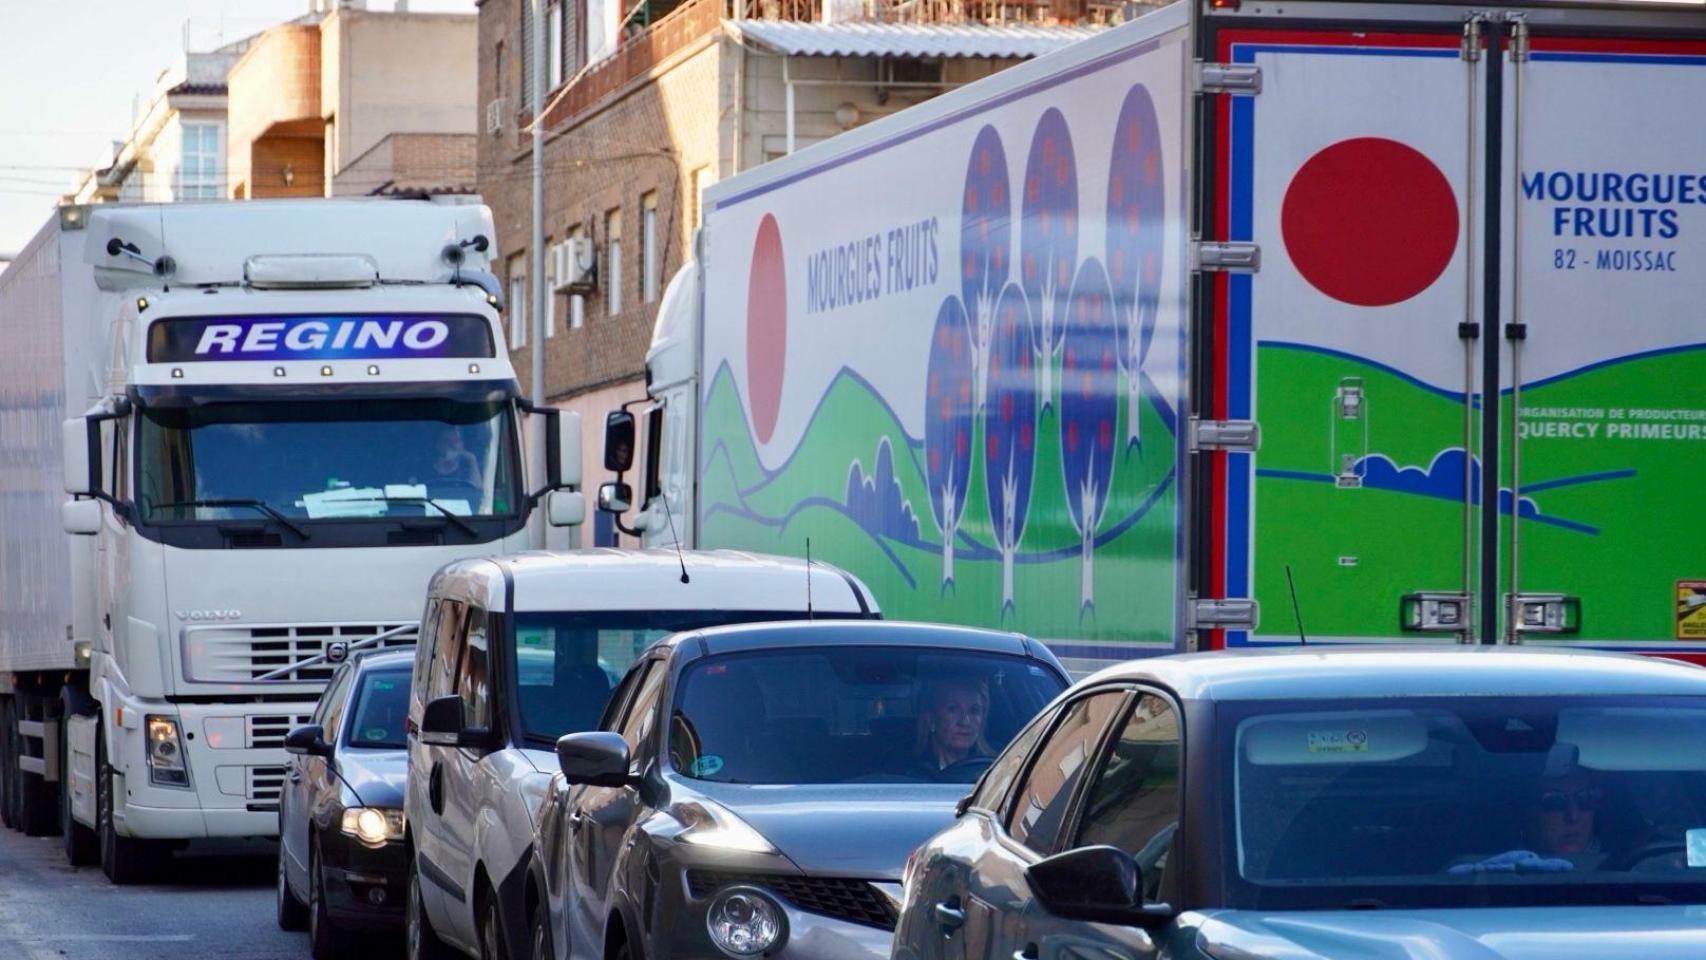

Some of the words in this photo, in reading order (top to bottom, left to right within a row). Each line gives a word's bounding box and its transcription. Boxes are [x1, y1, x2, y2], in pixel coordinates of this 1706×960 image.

[1554, 207, 1679, 239] FRUITS
[807, 232, 881, 314] MOURGUES
[886, 215, 938, 295] FRUITS
[1554, 248, 1576, 269] 82
[1596, 249, 1677, 272] MOISSAC
[195, 320, 449, 354] REGINO
[1608, 408, 1625, 419] DE
[1628, 409, 1706, 421] PRODUCTEUR
[1519, 422, 1599, 439] QUERCY
[175, 608, 241, 620] VOLVO
